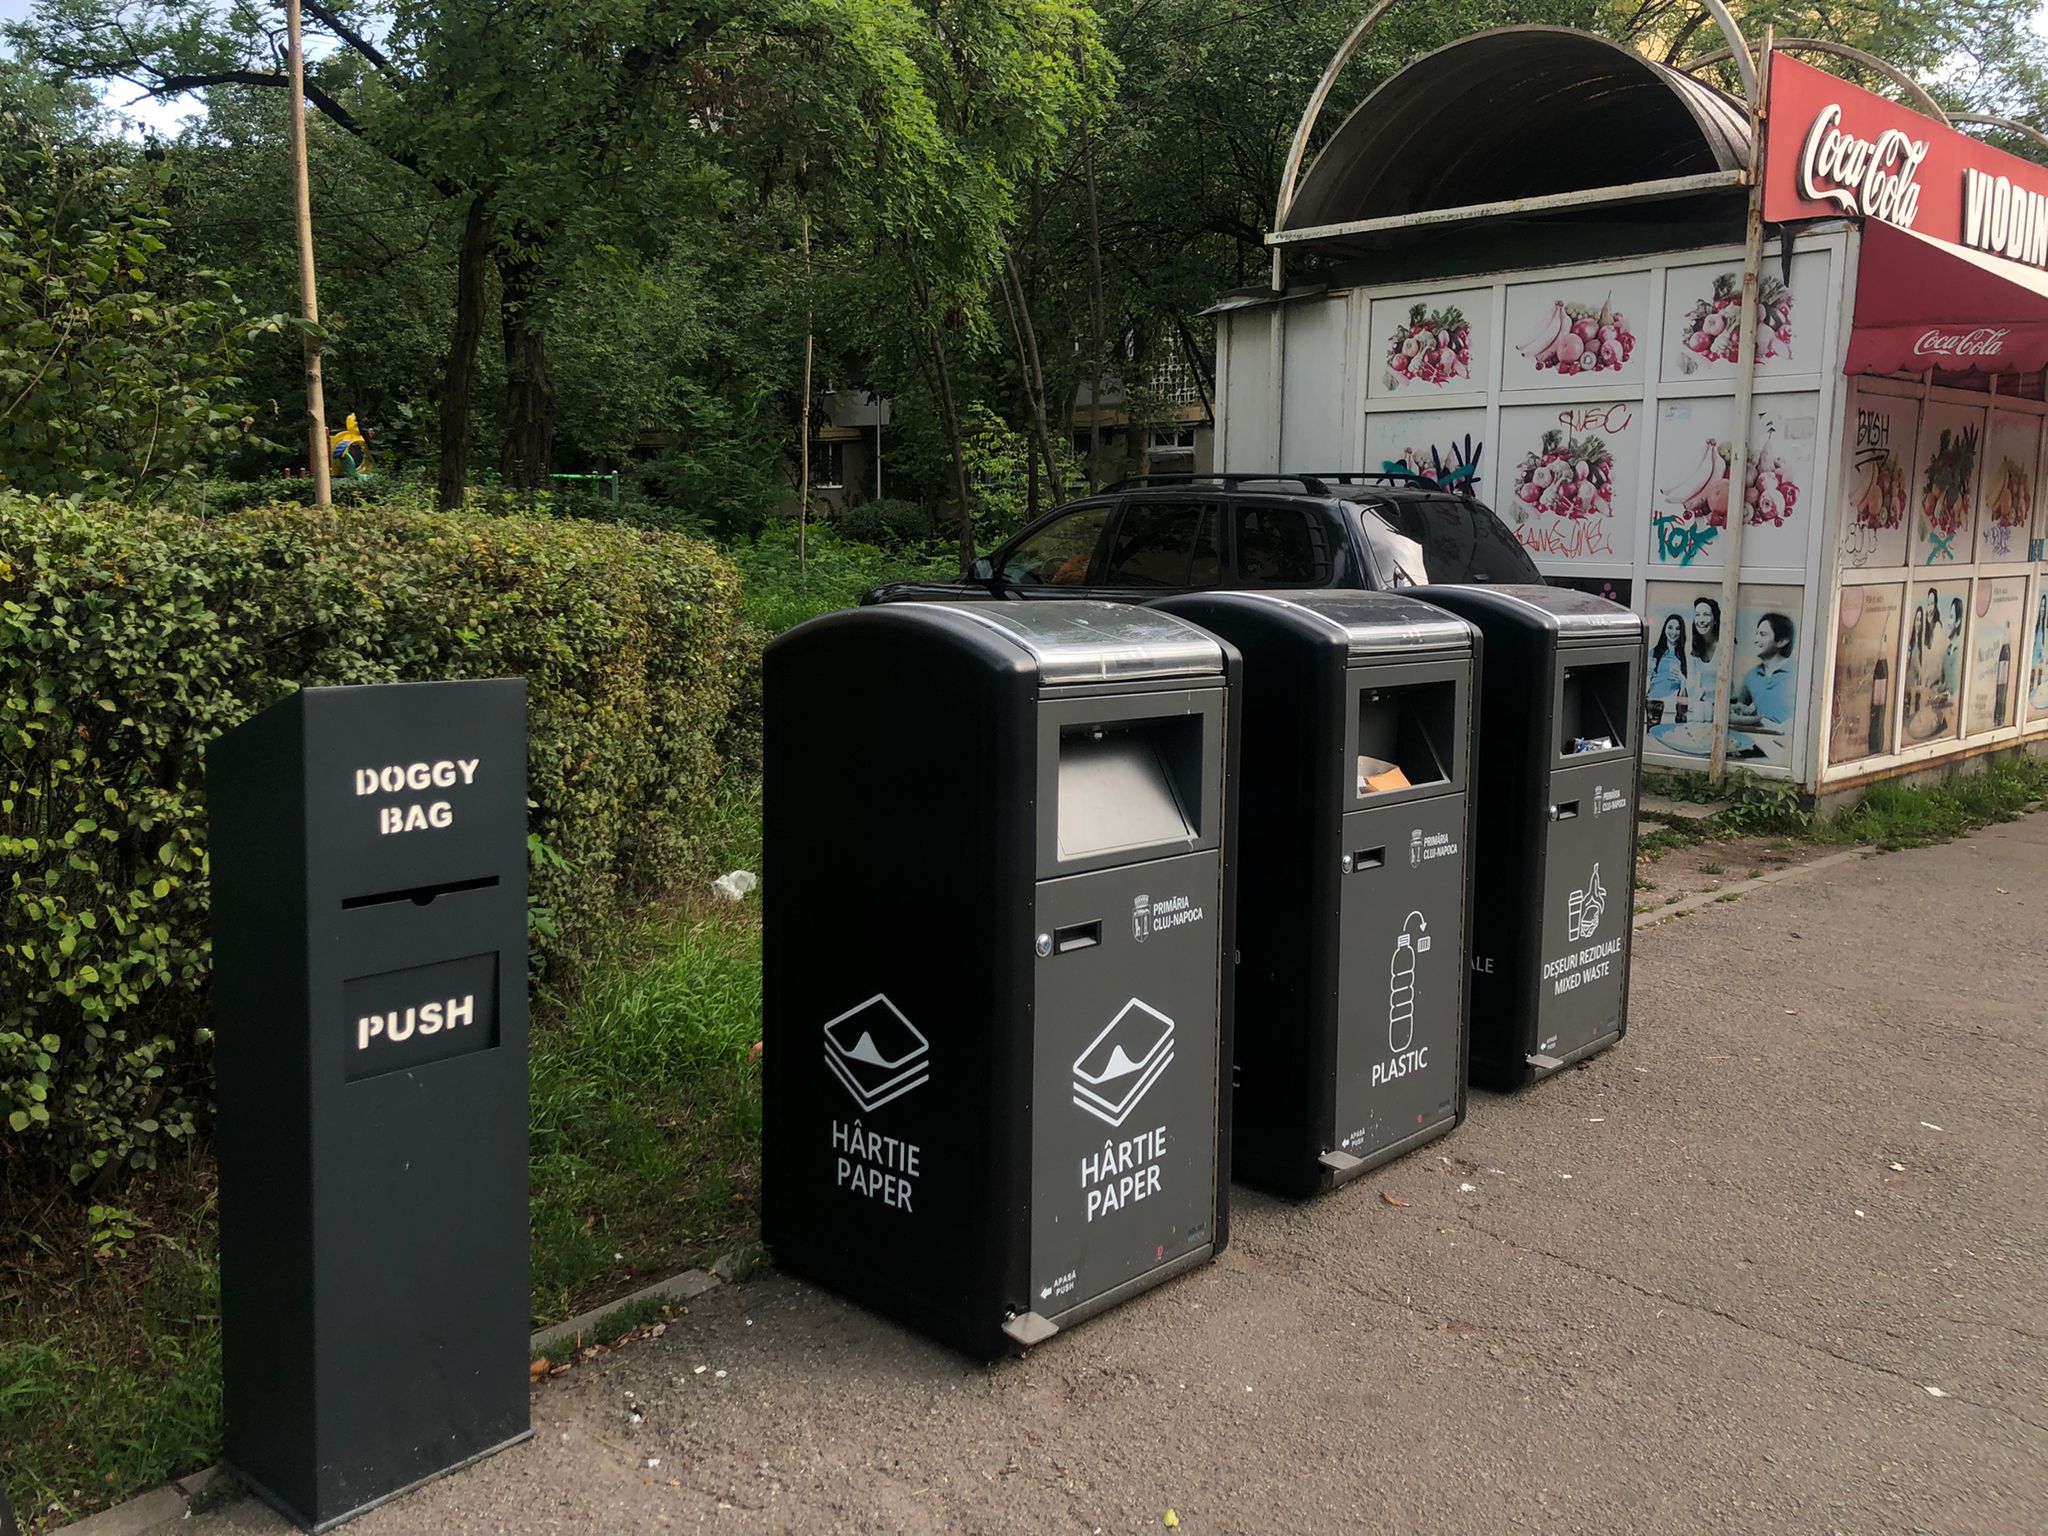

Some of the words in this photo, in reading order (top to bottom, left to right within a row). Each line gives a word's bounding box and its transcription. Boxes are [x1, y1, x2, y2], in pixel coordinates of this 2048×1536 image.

[1802, 103, 1930, 229] Coca-Cola
[1913, 328, 2011, 357] Coca-Cola
[355, 758, 480, 796] DOGGY
[380, 801, 454, 835] BAG
[1423, 832, 1449, 848] PRIMĂRIA
[1423, 843, 1458, 860] CLUJ-NAPOCA
[1153, 895, 1190, 916] PRIMĂRIA
[1153, 907, 1204, 932] CLUJ-NAPOCA
[1580, 937, 1622, 965] REZIDUALE
[1554, 973, 1582, 996] MIXED
[1583, 961, 1610, 984] WASTE
[357, 994, 475, 1050] PUSH
[1371, 1046, 1429, 1087] PLASTIC
[832, 1119, 921, 1178] HÂRTIE
[1080, 1124, 1167, 1189] HÂRTIE
[837, 1157, 913, 1213] PAPER
[1086, 1165, 1162, 1223] PAPER
[1056, 1280, 1075, 1297] PUSH
